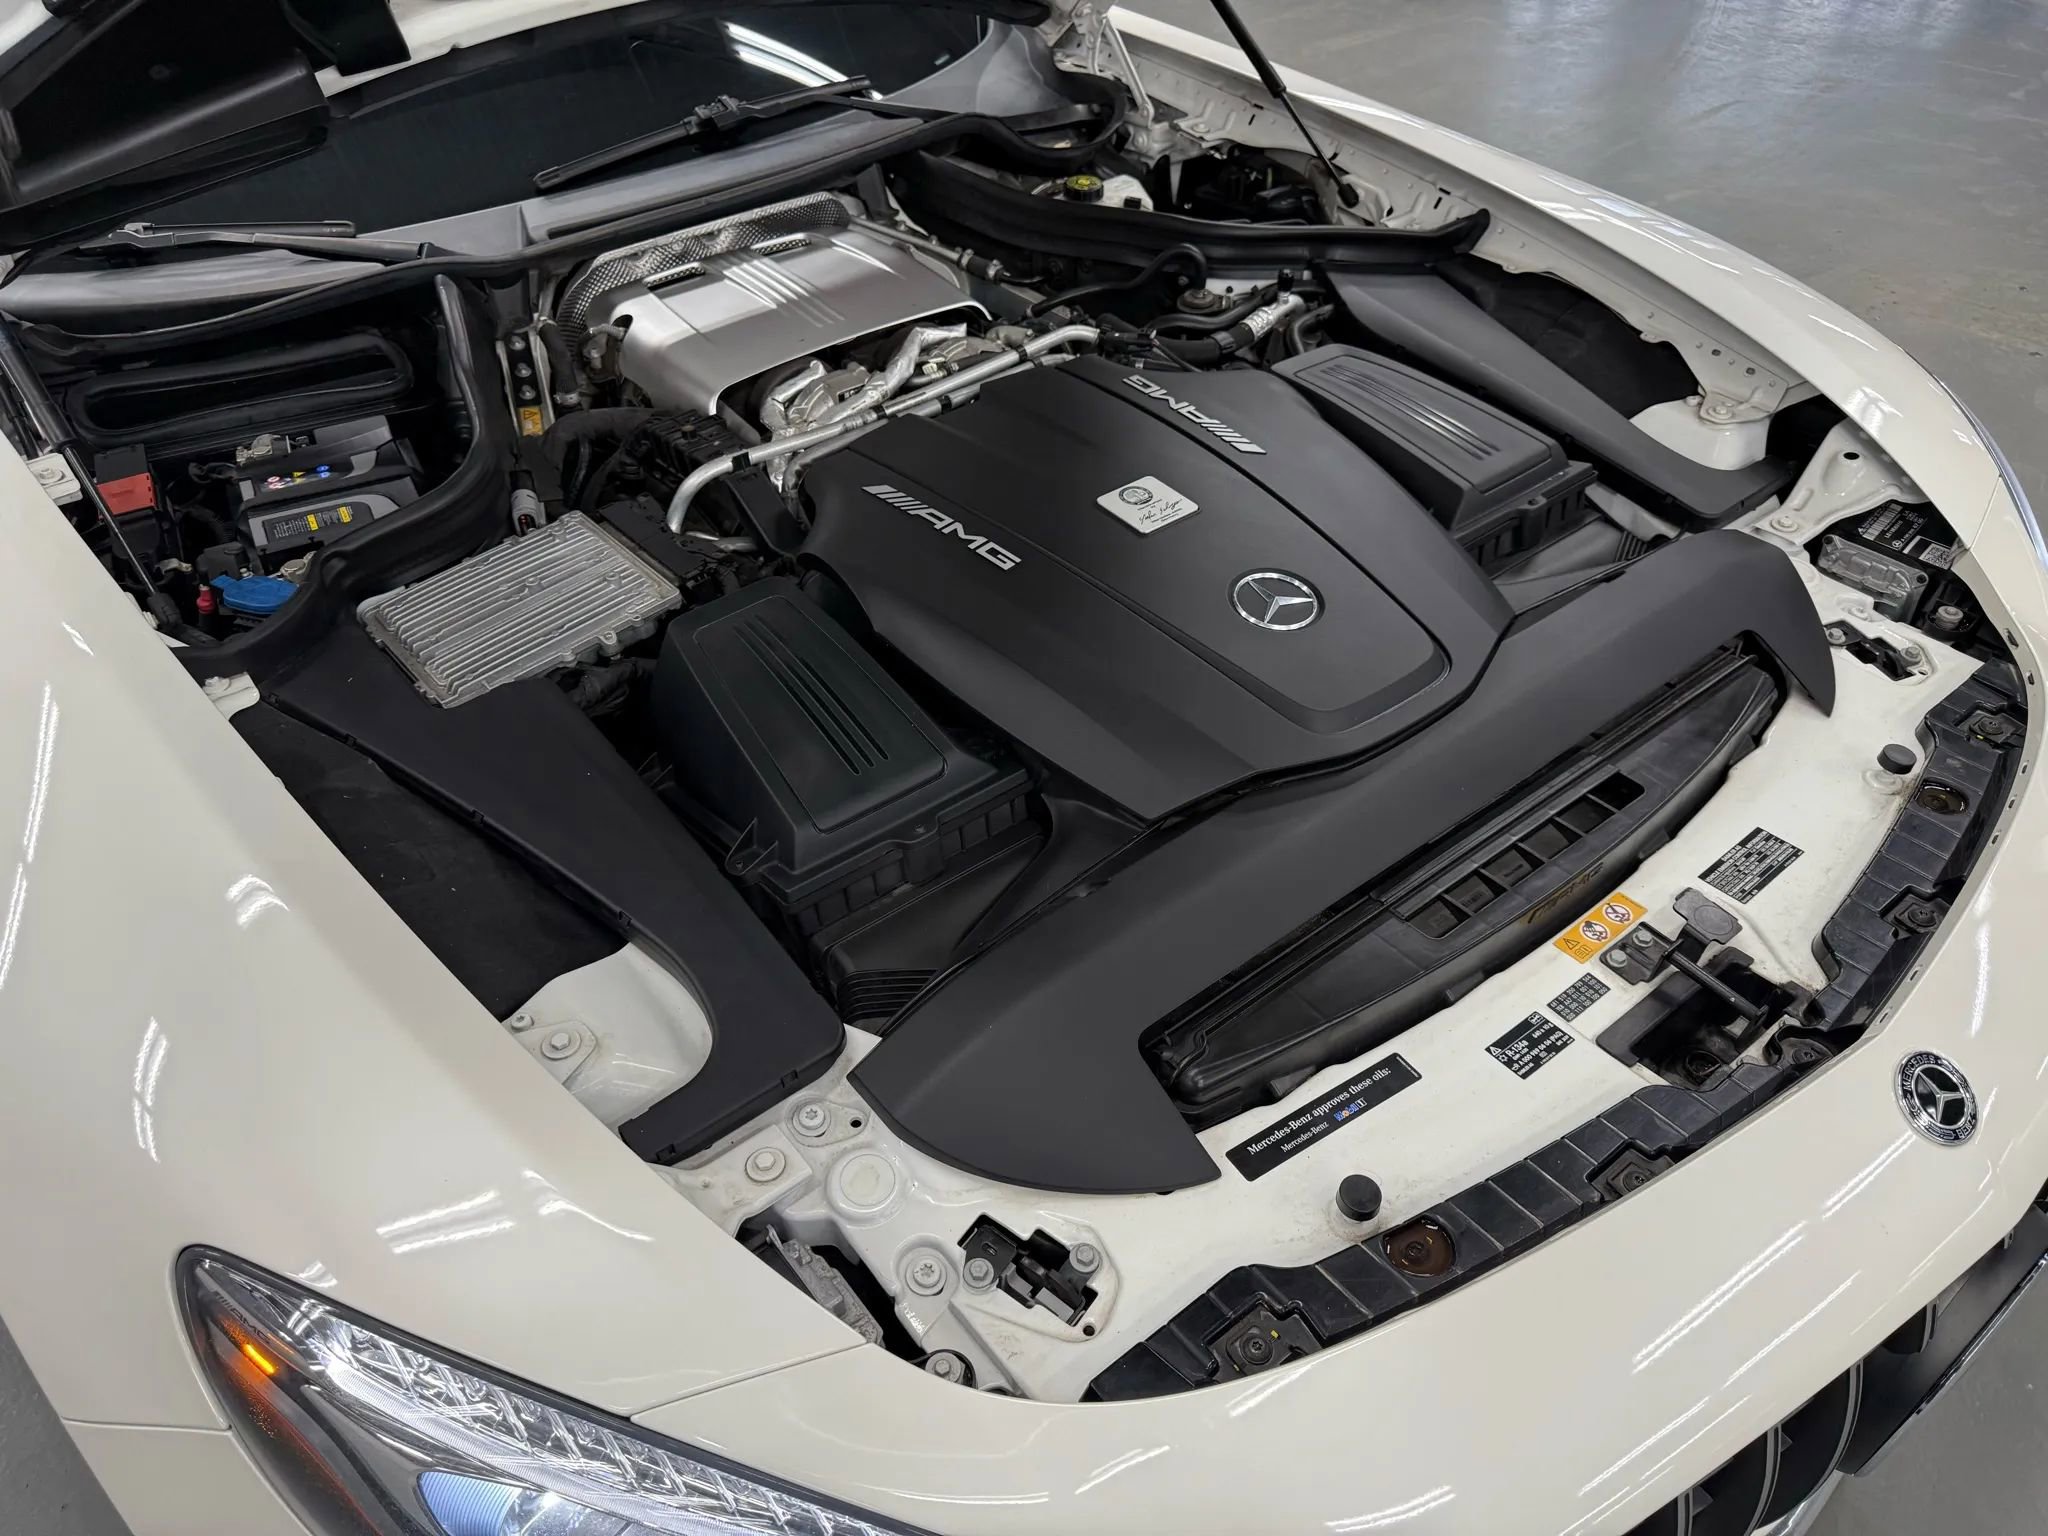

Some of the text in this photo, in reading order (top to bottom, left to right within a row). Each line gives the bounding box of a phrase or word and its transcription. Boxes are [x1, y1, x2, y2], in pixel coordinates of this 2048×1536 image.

[1505, 1039, 1530, 1057] R-134a
[1902, 1054, 1936, 1091] MERCEDES
[1247, 1112, 1313, 1156] Mercedes-Benz
[1312, 1091, 1350, 1118] approves
[1349, 1078, 1374, 1095] these
[1372, 1066, 1392, 1082] oils:
[1956, 1113, 1976, 1138] BENZ
[1280, 1121, 1330, 1153] Mercedes-Benz
